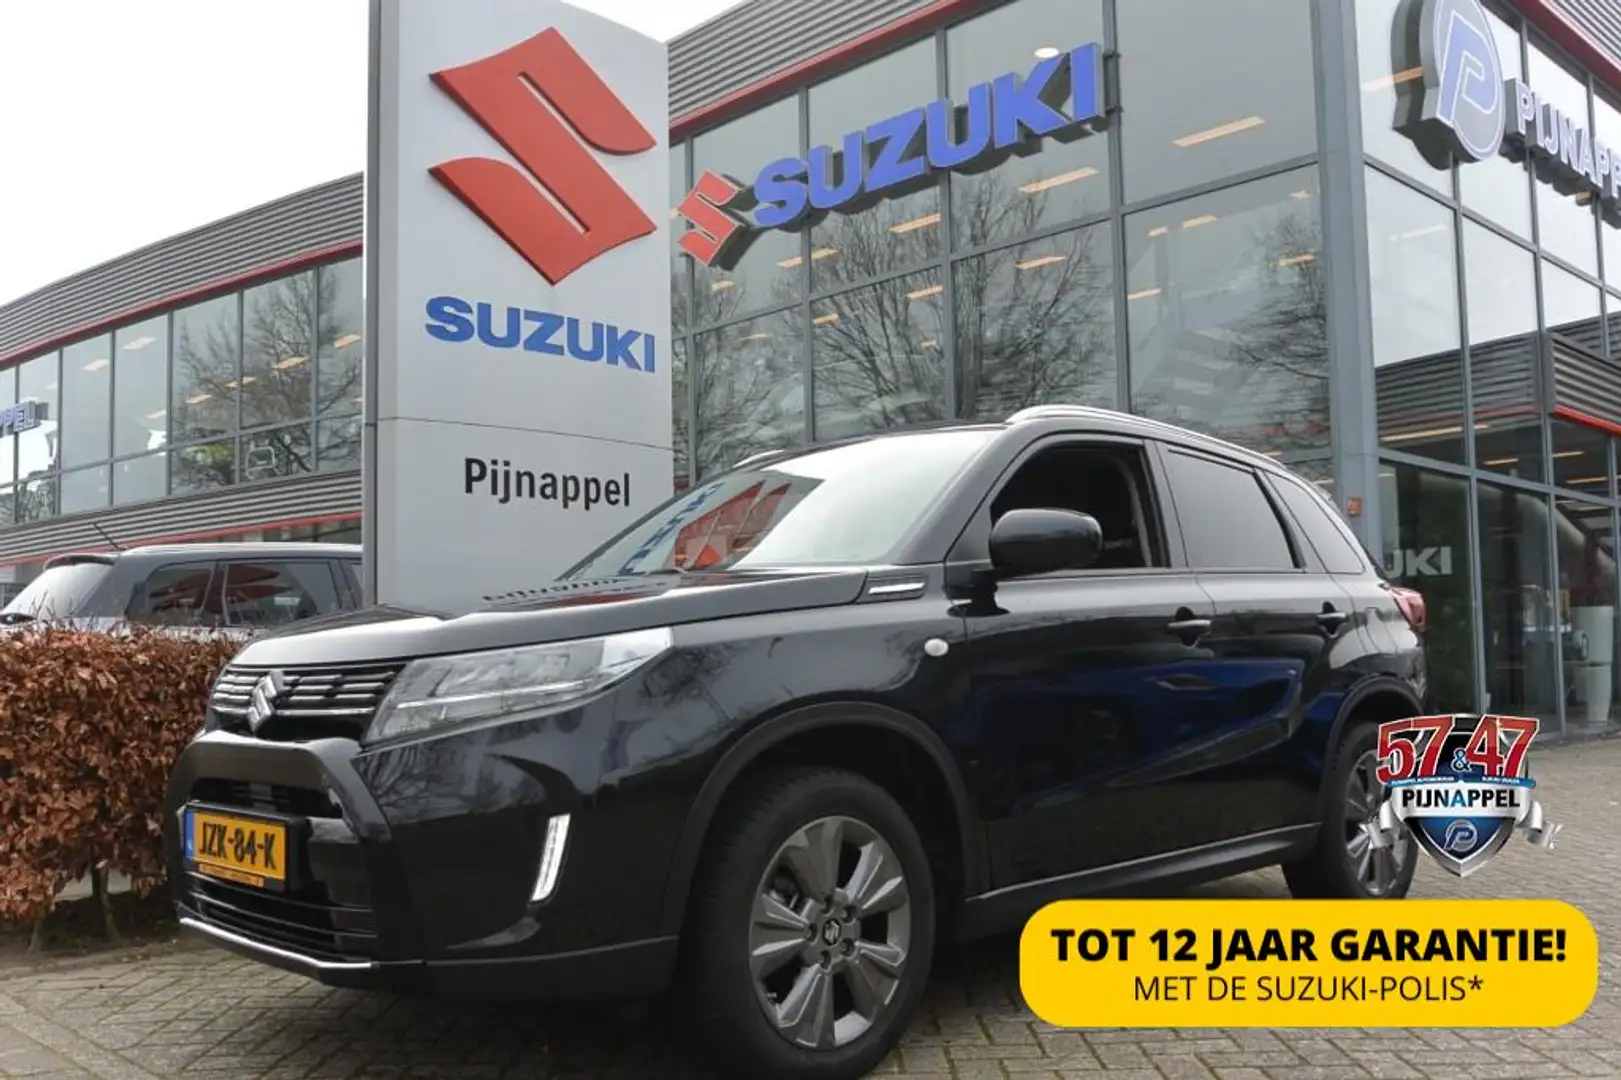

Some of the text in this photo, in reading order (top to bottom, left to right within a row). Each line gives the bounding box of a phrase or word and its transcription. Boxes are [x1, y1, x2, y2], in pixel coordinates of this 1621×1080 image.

[753, 42, 1099, 228] SUZUKI
[425, 295, 656, 373] SUZUKI
[465, 457, 630, 511] Pijnappel
[199, 821, 277, 871] JZK-84-K
